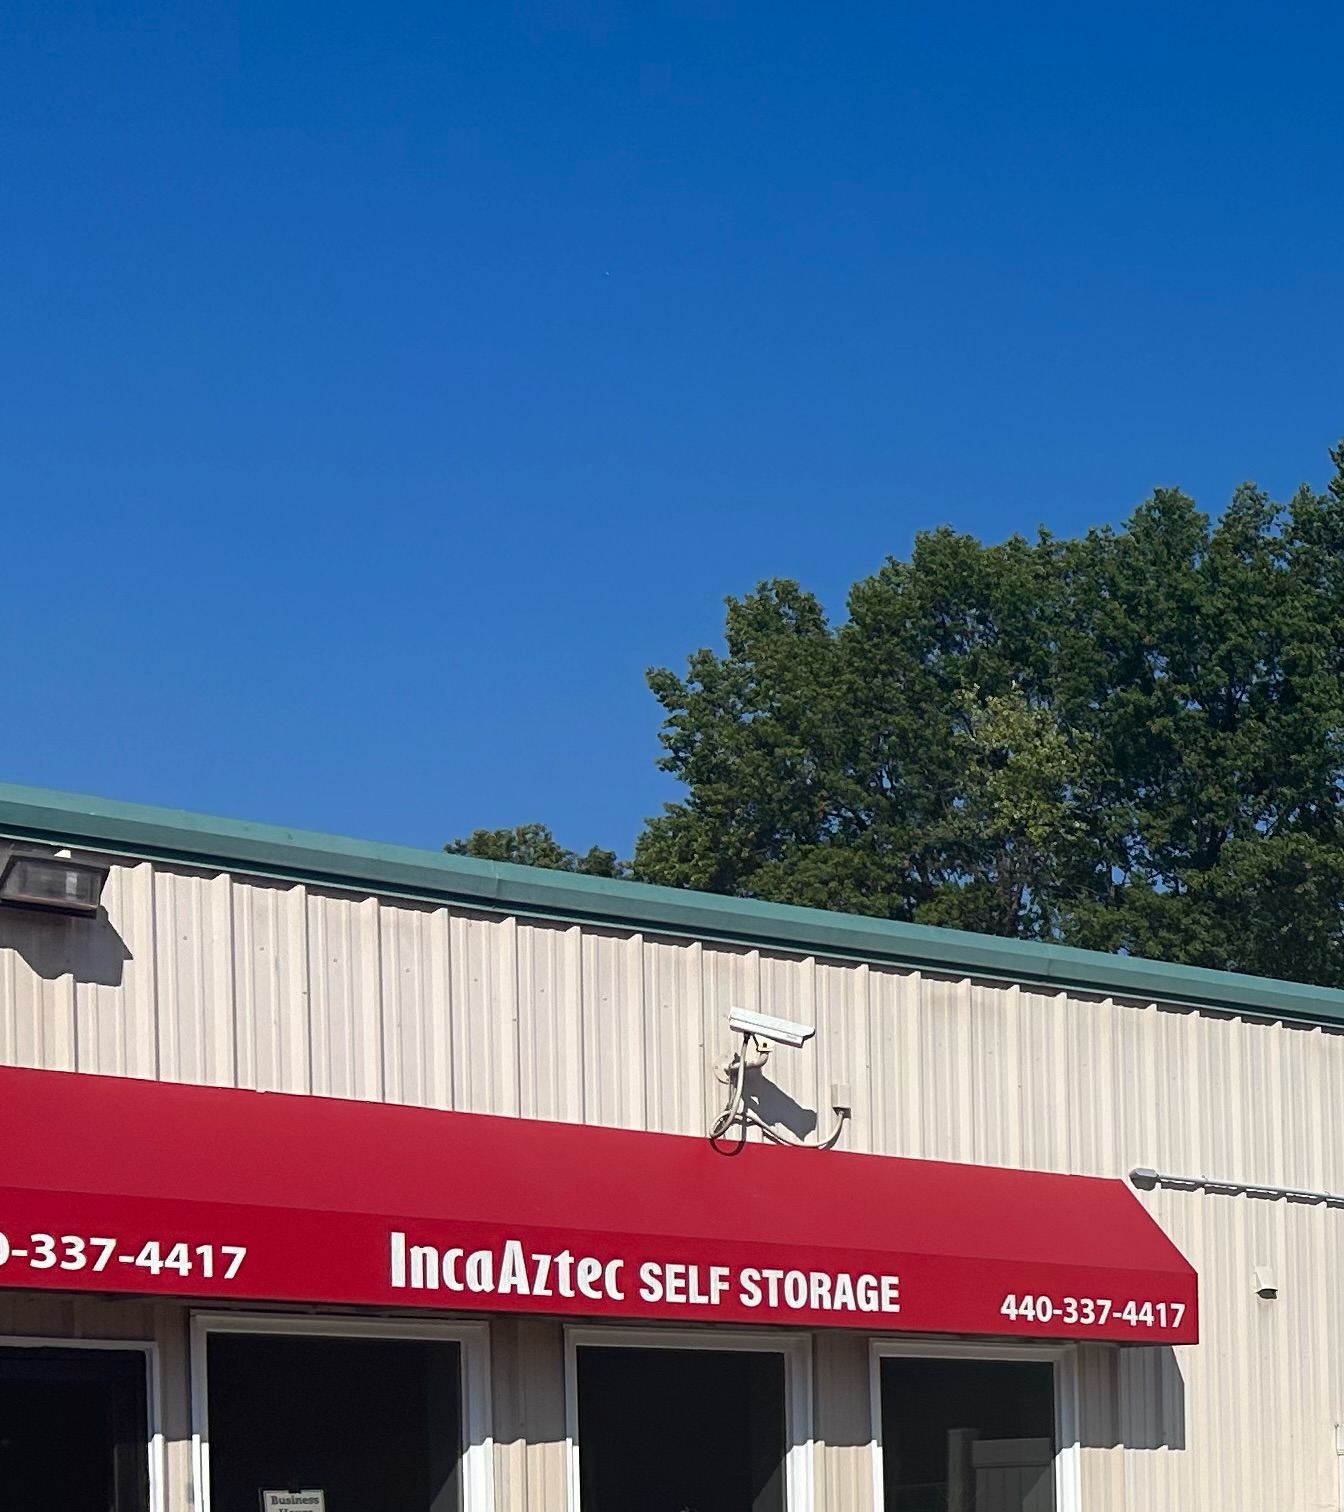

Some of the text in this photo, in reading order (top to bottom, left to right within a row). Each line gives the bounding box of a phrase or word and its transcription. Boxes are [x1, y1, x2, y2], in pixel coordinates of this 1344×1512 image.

[389, 1231, 901, 1313] IncaAztec SELF STORAGE
[999, 1294, 1187, 1329] 440-337-4417
[271, 1495, 320, 1505] Business
